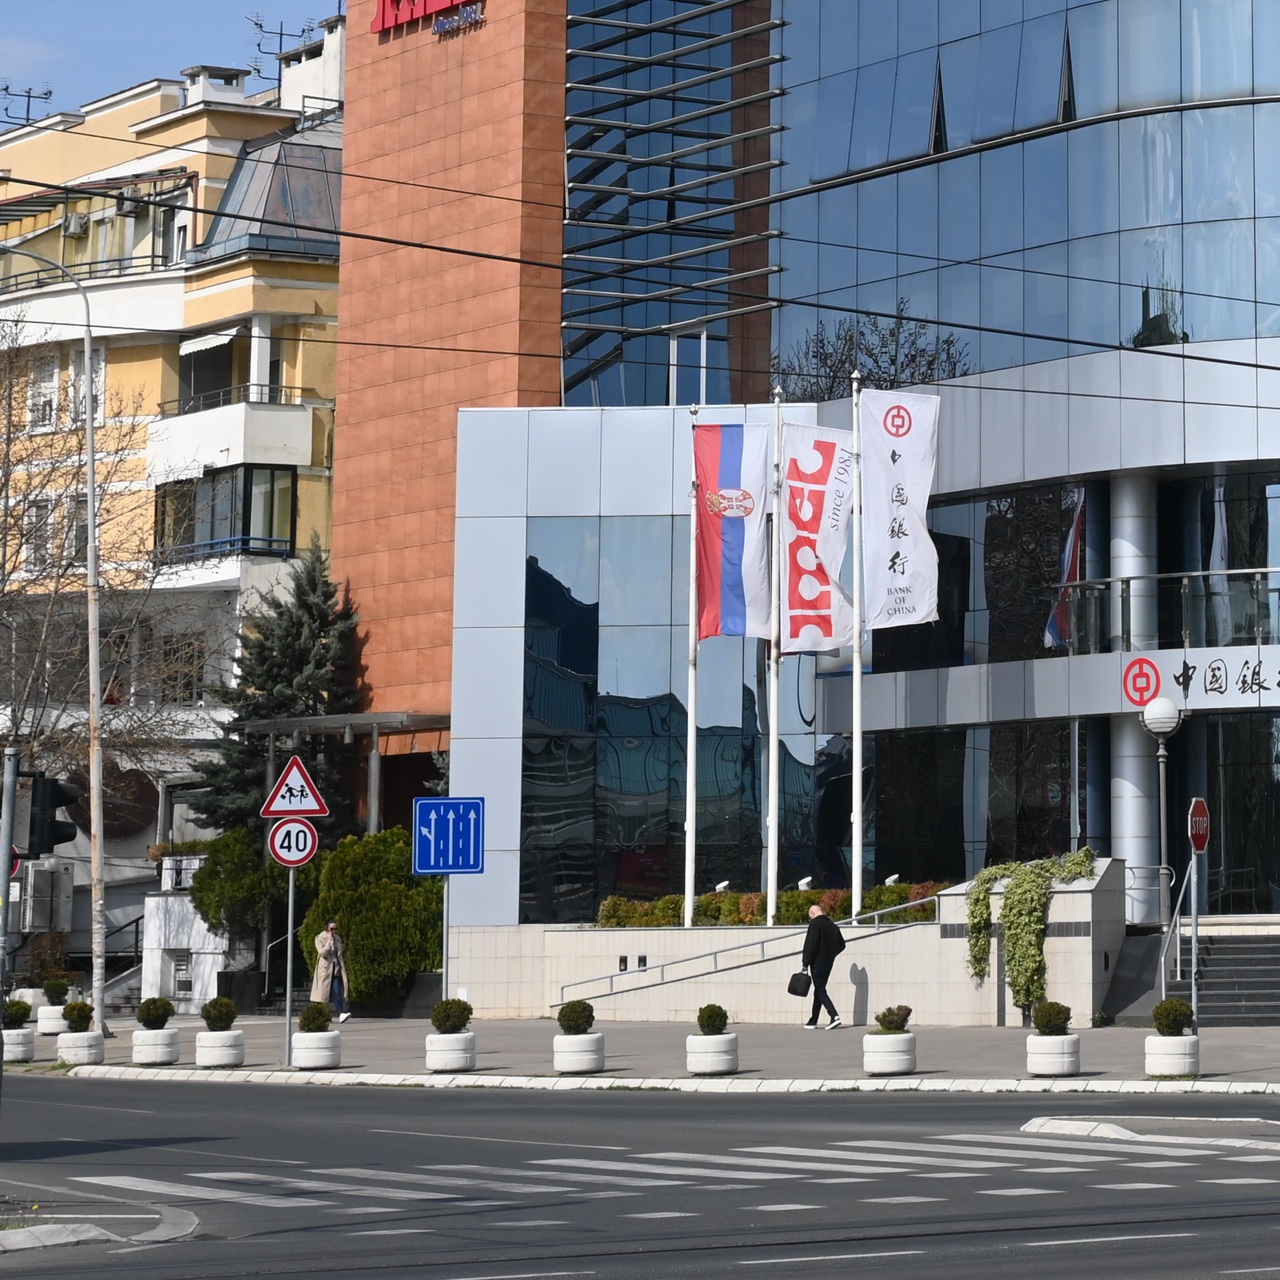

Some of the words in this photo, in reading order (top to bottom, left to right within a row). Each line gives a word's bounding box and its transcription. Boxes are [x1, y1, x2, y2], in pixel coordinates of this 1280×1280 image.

[827, 489, 845, 531] since
[886, 585, 913, 596] BANK
[894, 596, 907, 605] OF
[886, 605, 917, 616] CHINA
[1192, 816, 1208, 835] STOP
[279, 829, 308, 853] 40
